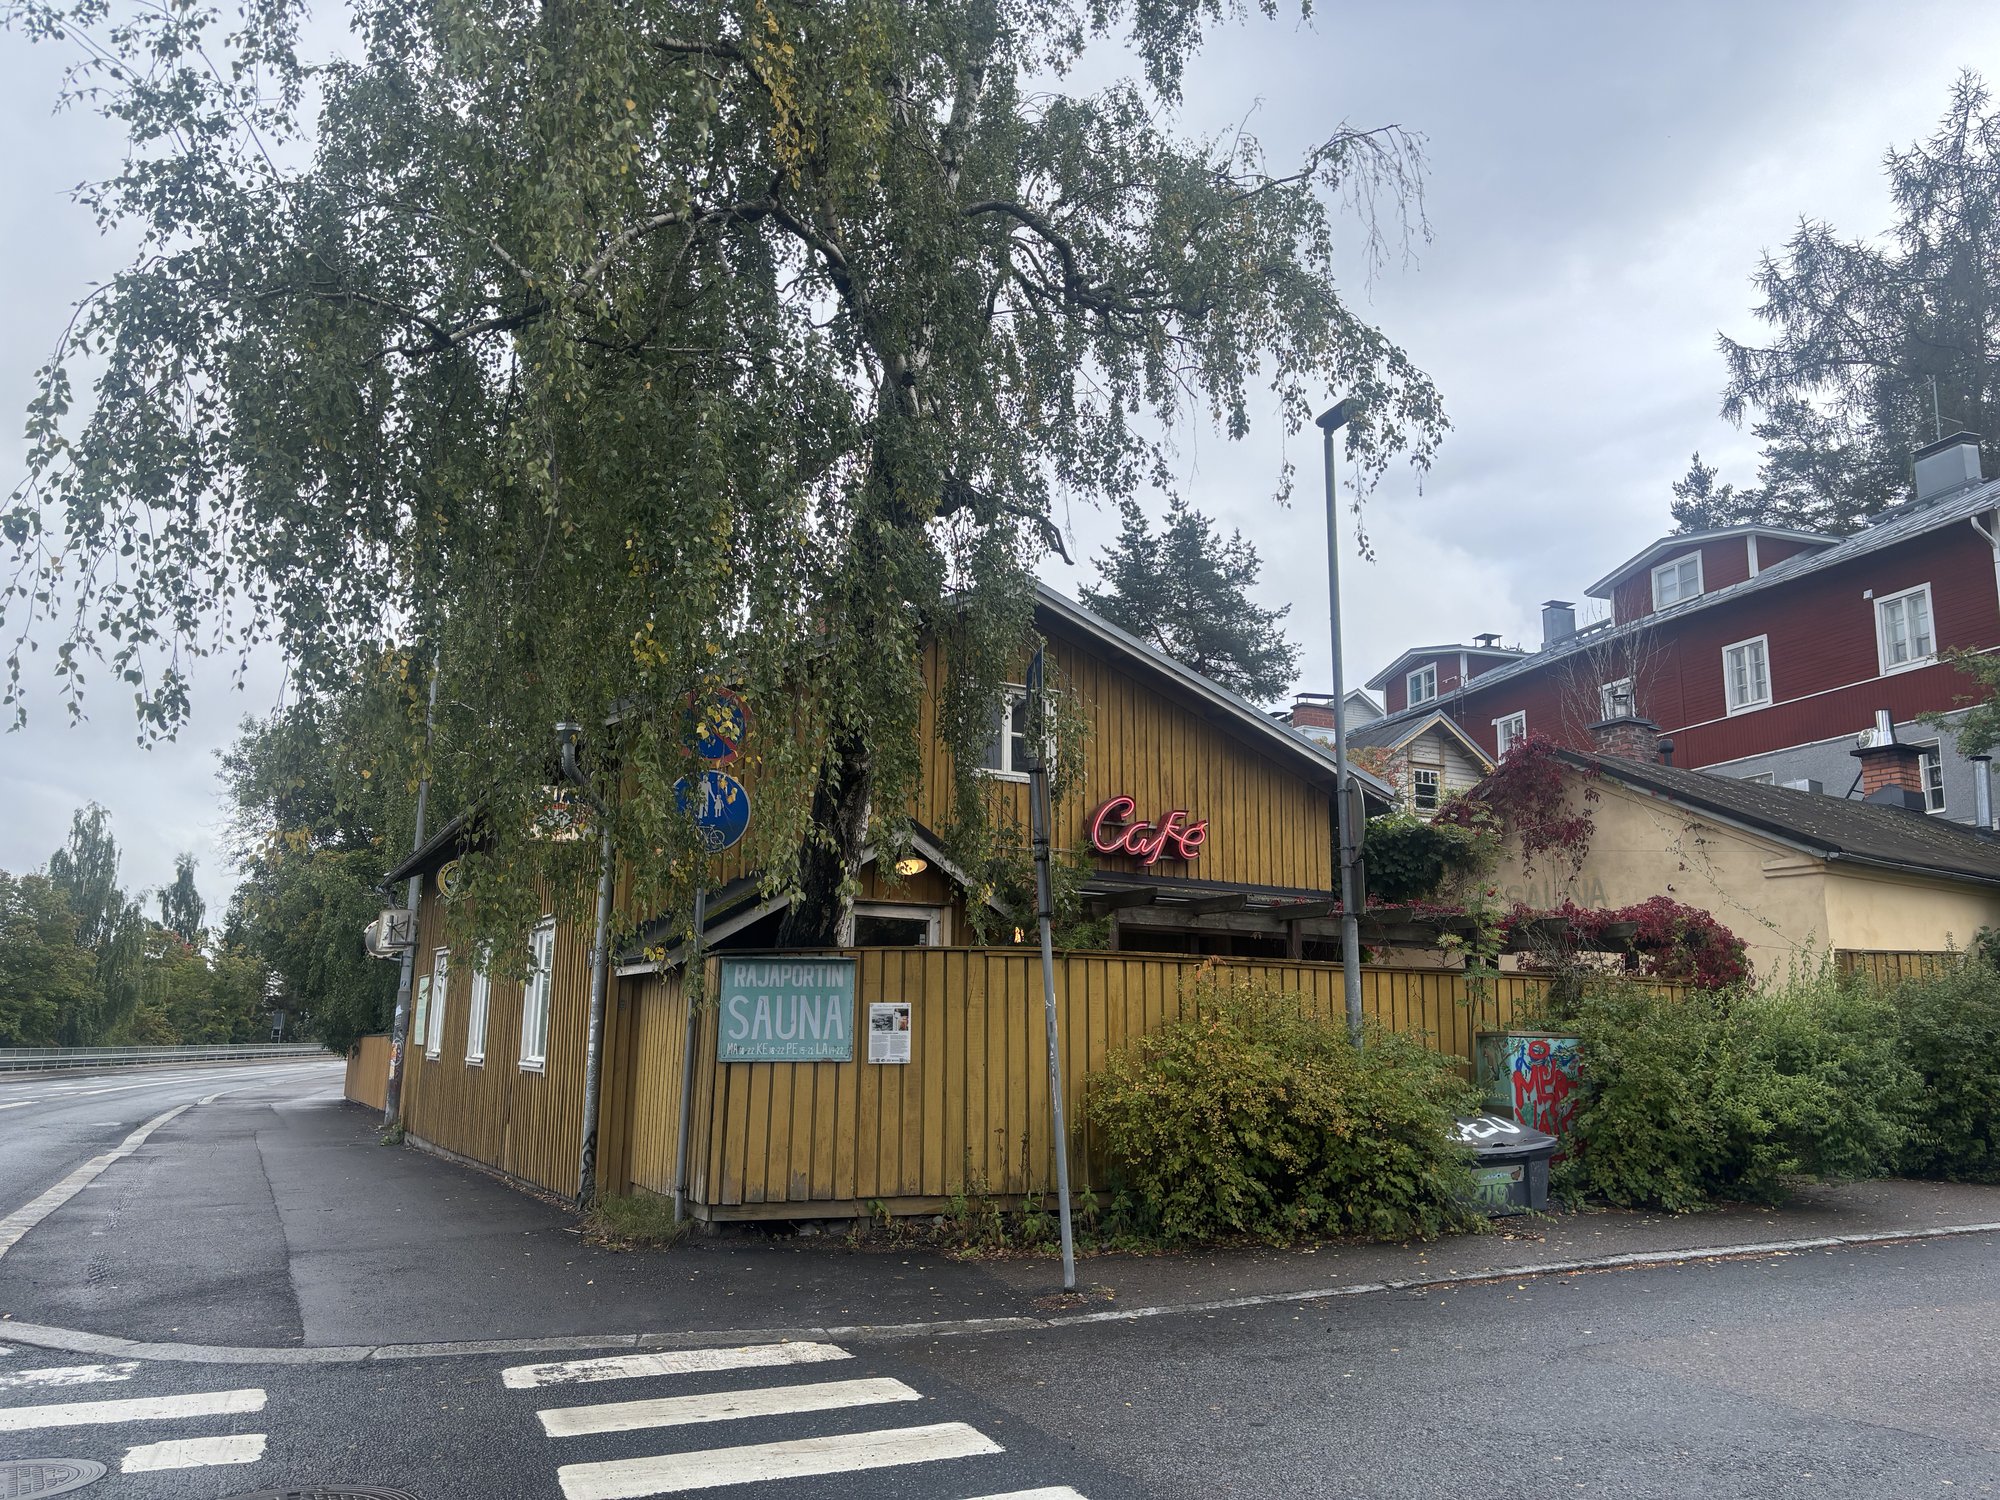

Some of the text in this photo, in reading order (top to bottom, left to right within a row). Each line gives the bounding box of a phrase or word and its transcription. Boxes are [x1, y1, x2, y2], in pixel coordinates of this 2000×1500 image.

[1091, 795, 1208, 866] Café
[734, 964, 844, 988] RAJAPORTIN
[728, 995, 844, 1040] SAUNA
[727, 1042, 738, 1055] MA
[756, 1042, 769, 1055] KE
[786, 1042, 799, 1055] PE
[815, 1042, 828, 1055] LA
